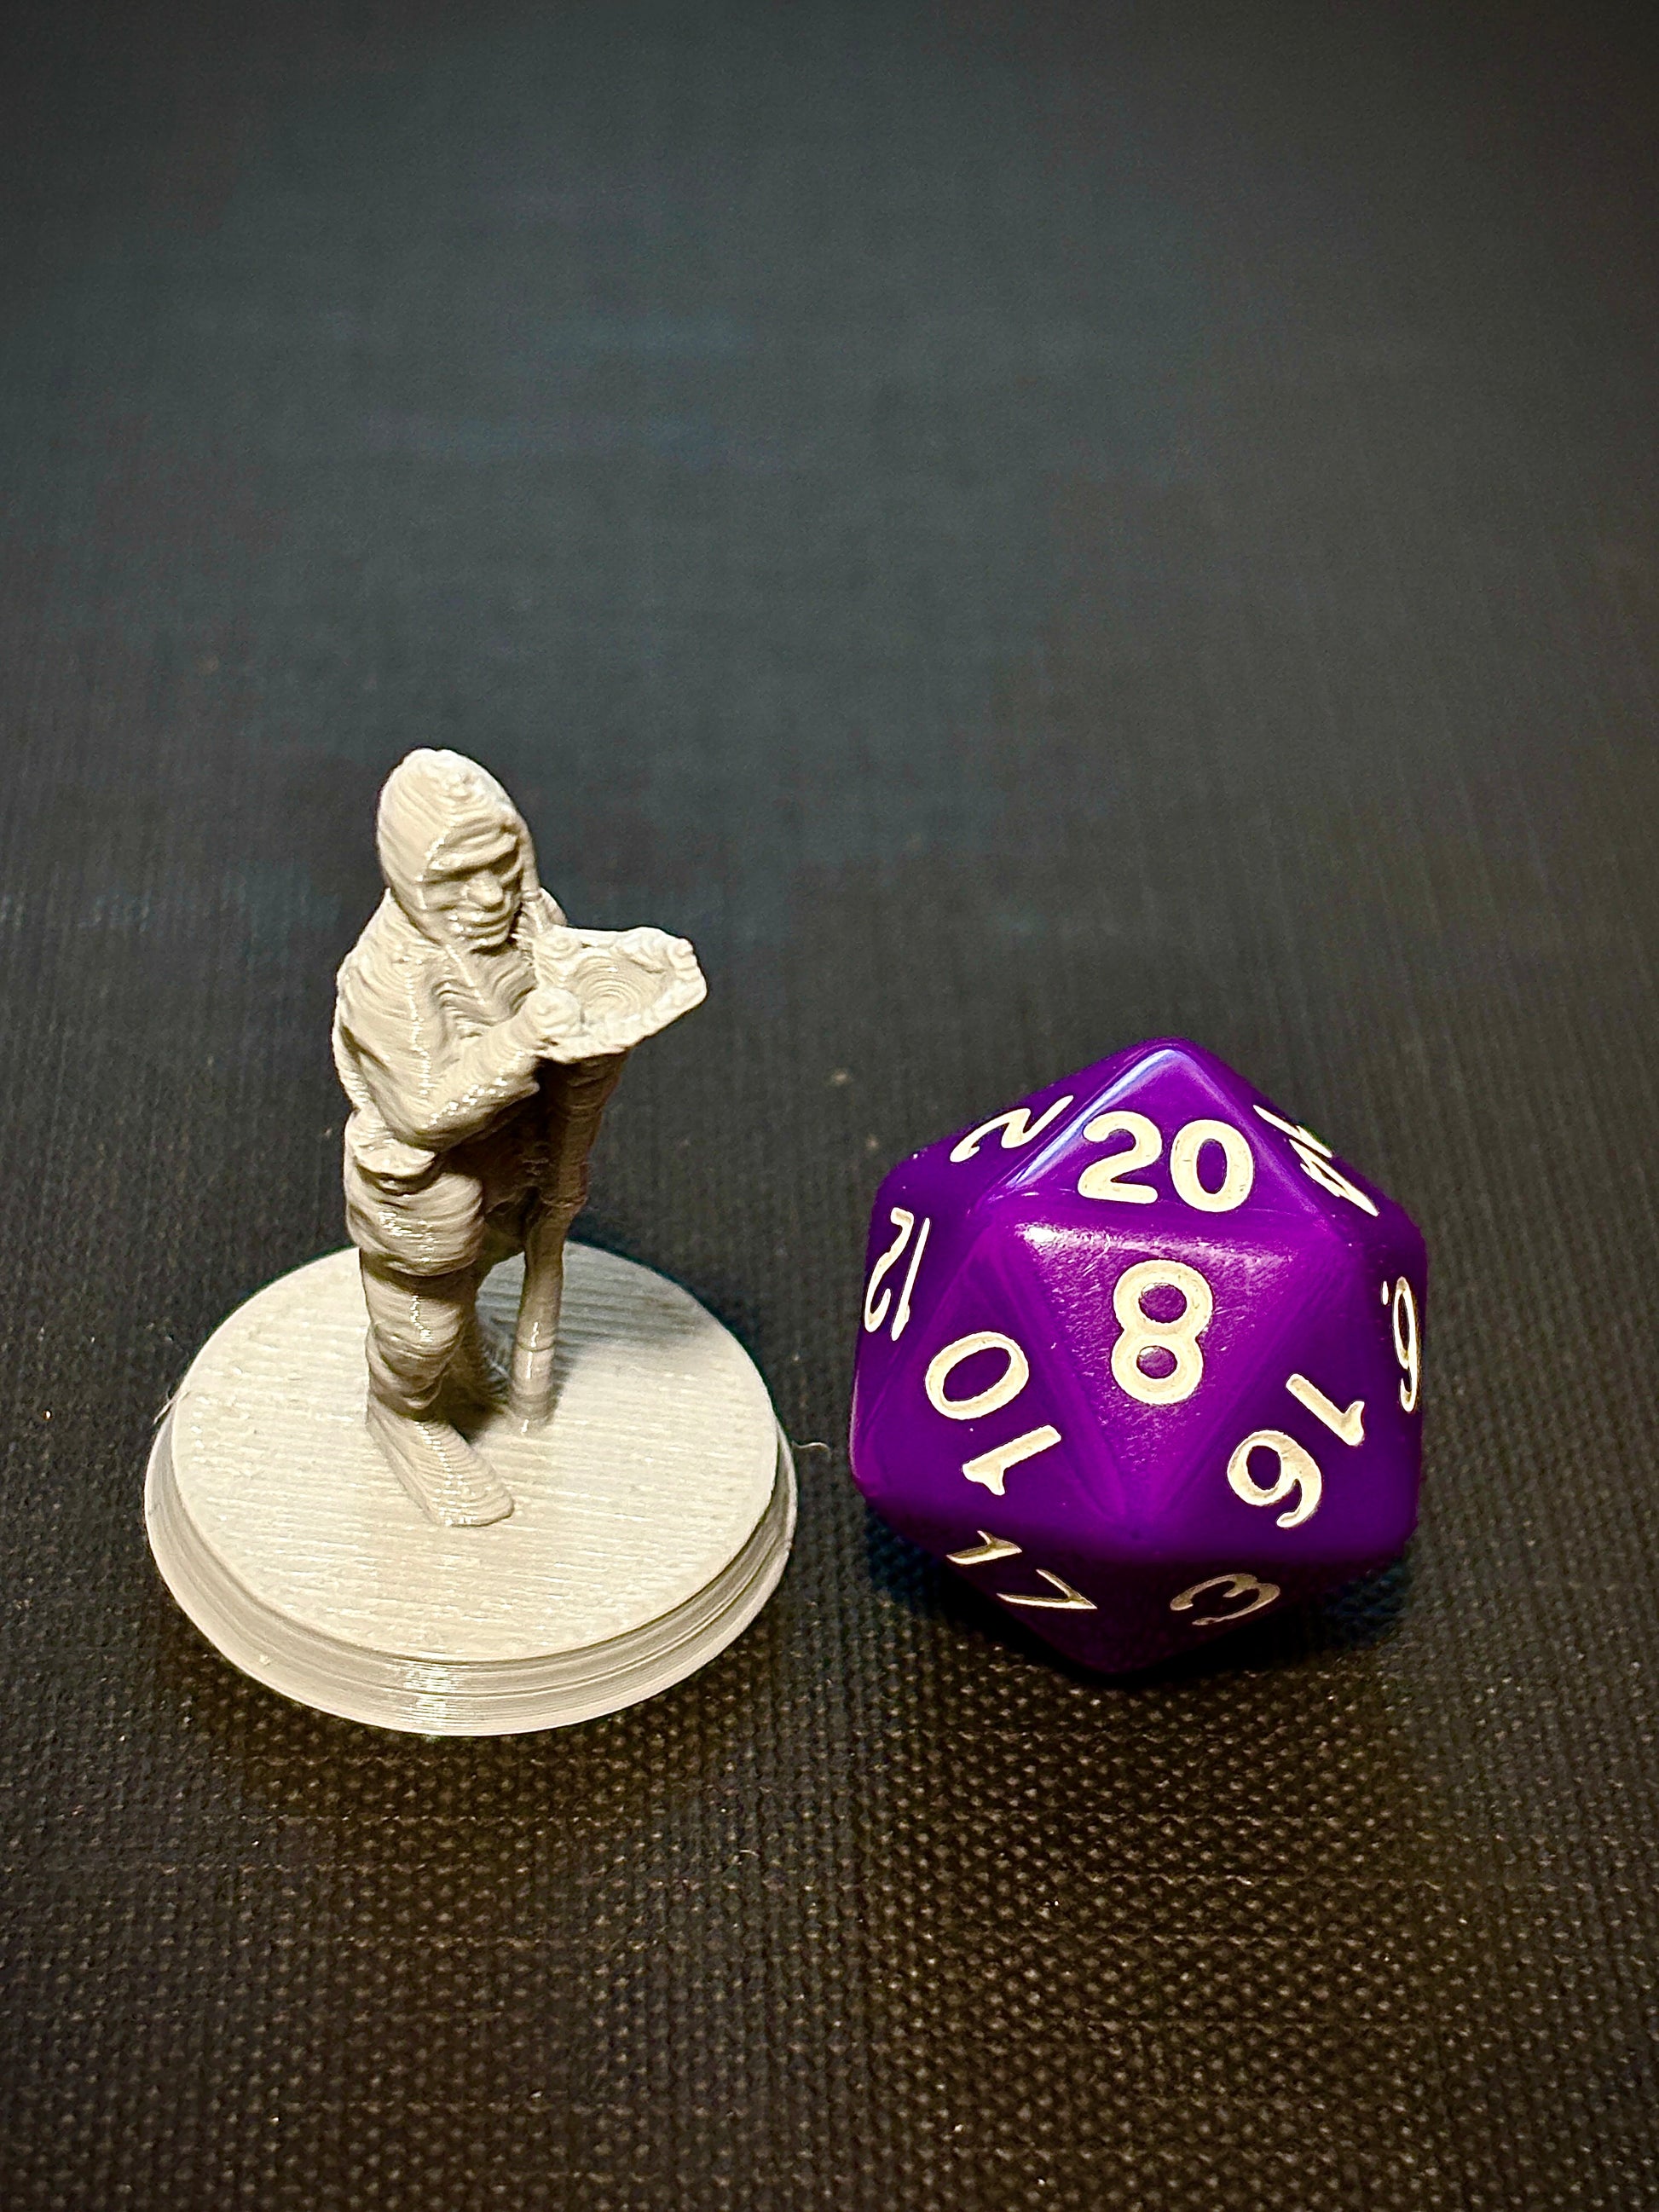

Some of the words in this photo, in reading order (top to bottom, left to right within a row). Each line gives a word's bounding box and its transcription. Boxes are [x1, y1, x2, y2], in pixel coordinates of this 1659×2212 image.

[950, 1095, 1074, 1163] 2
[1077, 1111, 1256, 1213] 20
[864, 1207, 931, 1342] 12
[1111, 1259, 1214, 1406] 8
[925, 1331, 1062, 1496] 10
[1227, 1373, 1365, 1528] 16
[946, 1530, 1099, 1610] 17
[1170, 1574, 1280, 1626] 3
